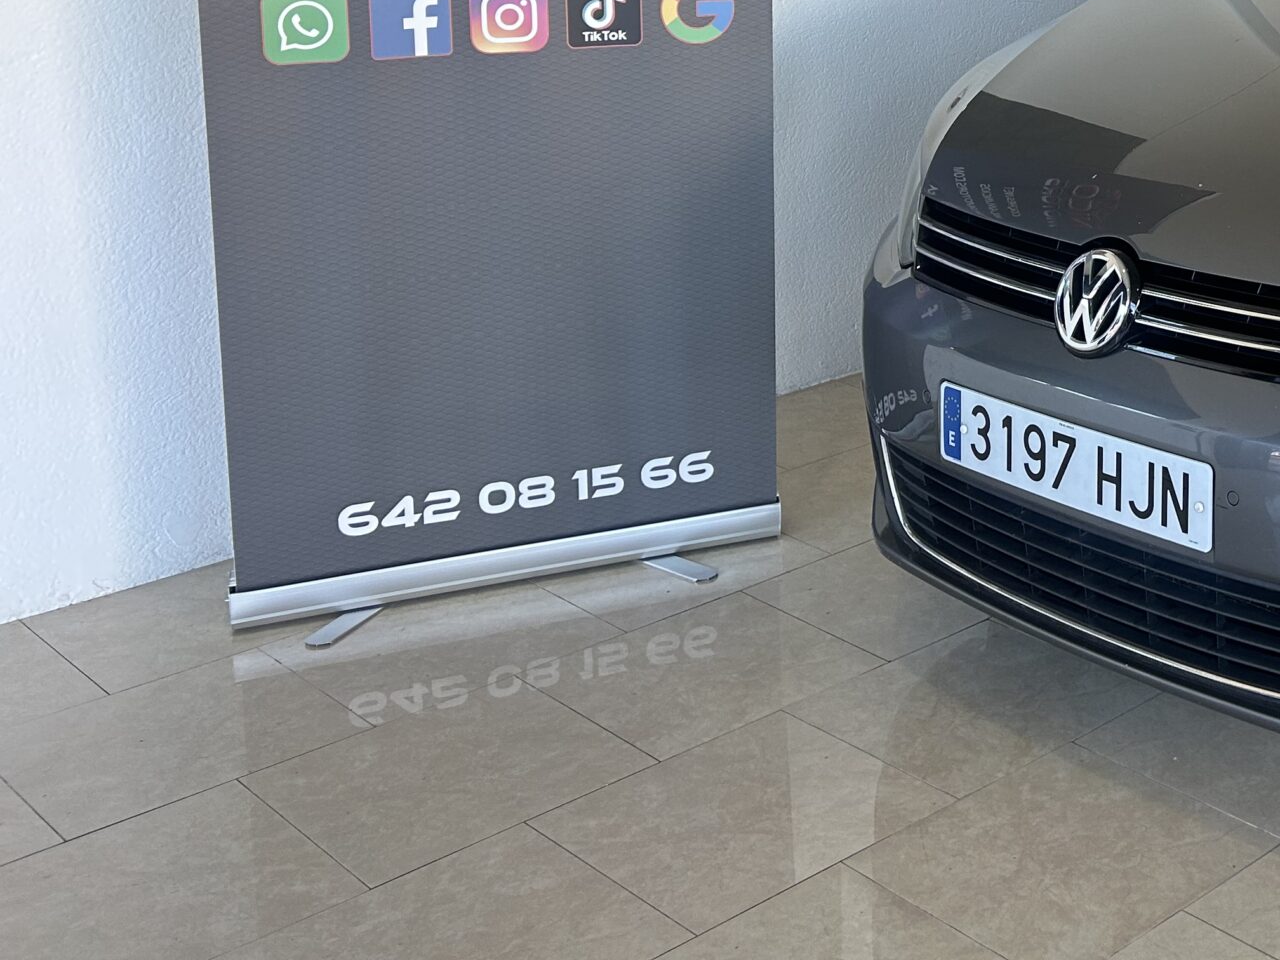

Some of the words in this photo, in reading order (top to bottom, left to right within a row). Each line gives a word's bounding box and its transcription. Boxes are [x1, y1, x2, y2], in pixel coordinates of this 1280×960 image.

[582, 29, 627, 42] TikTok
[948, 430, 956, 448] E
[338, 489, 461, 536] 642
[478, 475, 555, 514] 08
[571, 464, 624, 500] 15
[641, 450, 714, 489] 66
[970, 405, 1077, 489] 3197
[1096, 446, 1190, 534] HJN
